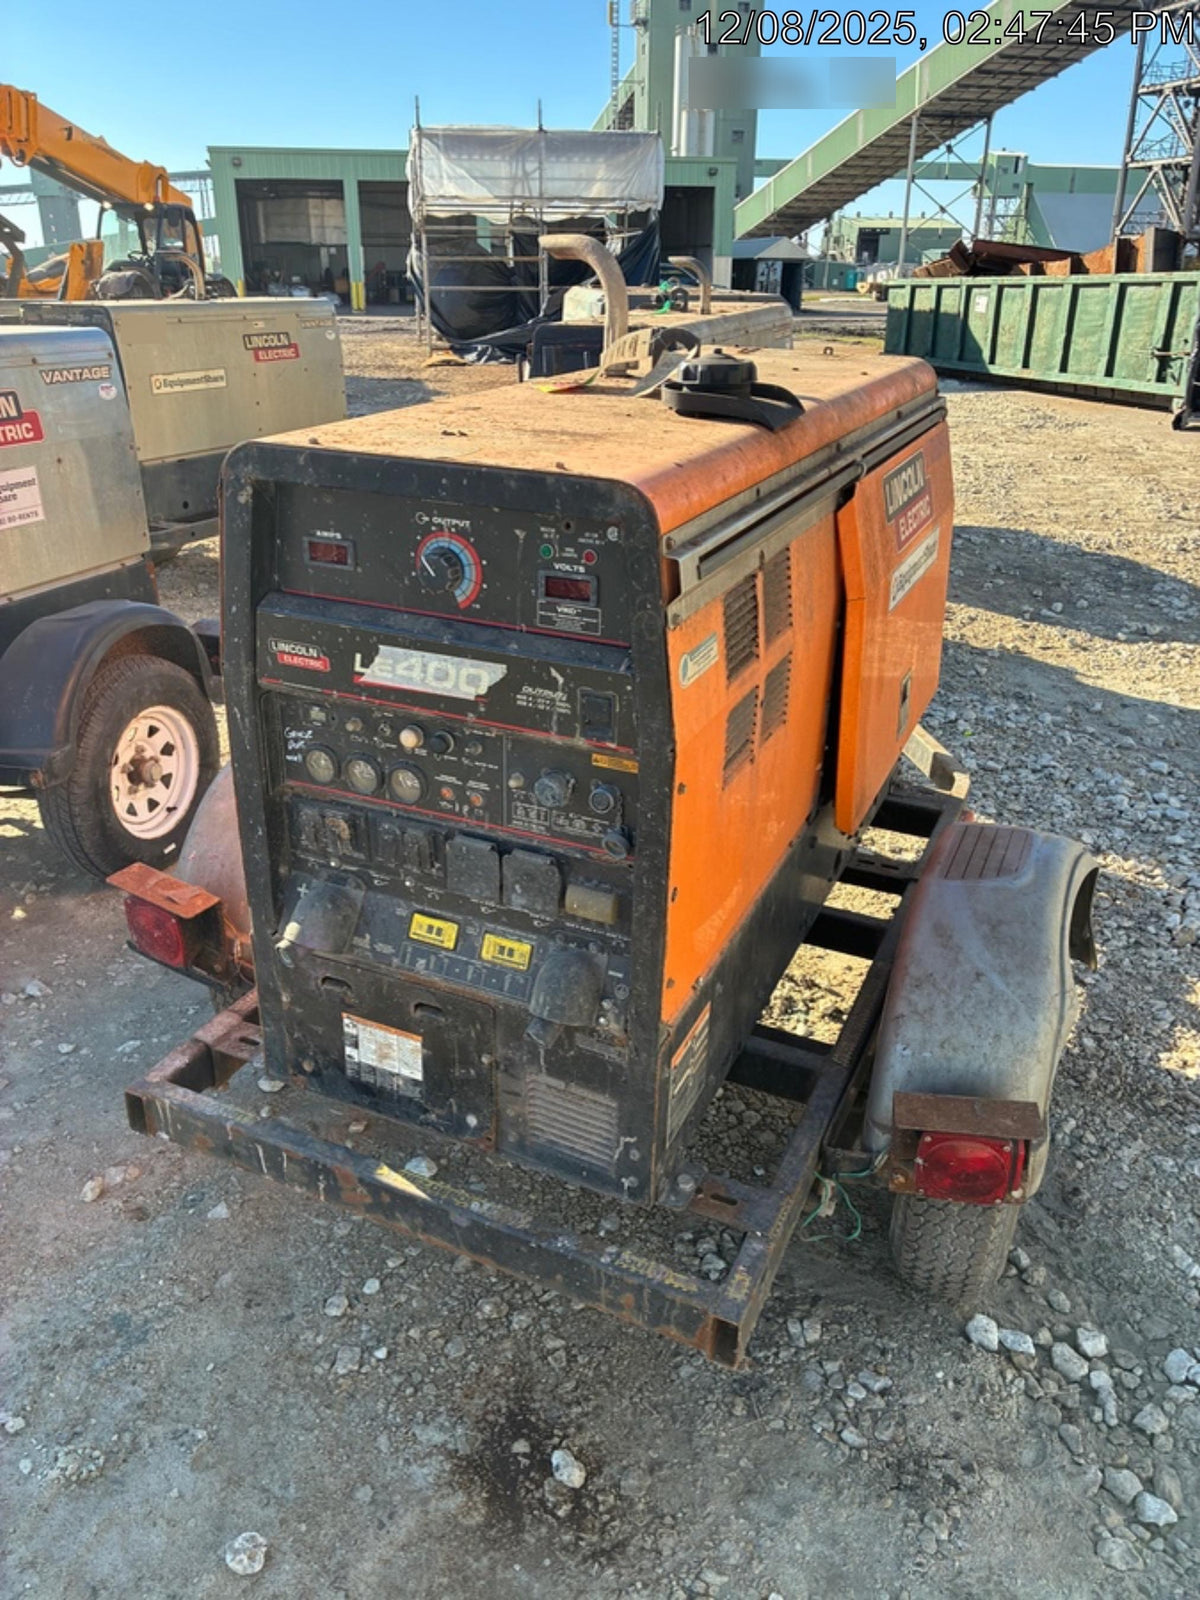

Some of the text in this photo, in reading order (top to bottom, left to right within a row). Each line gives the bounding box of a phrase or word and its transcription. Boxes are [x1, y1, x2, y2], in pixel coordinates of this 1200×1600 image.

[244, 332, 290, 349] LINCOLN
[258, 347, 298, 360] ELECTRIC
[41, 365, 111, 384] VANTAGE
[886, 457, 925, 516] LINCOLN
[432, 517, 470, 527] OUTPUT
[898, 494, 931, 541] ELECTRIC
[553, 562, 586, 573] VOLTS
[271, 641, 318, 658] LINCOLN
[283, 653, 325, 670] ELECTRIC
